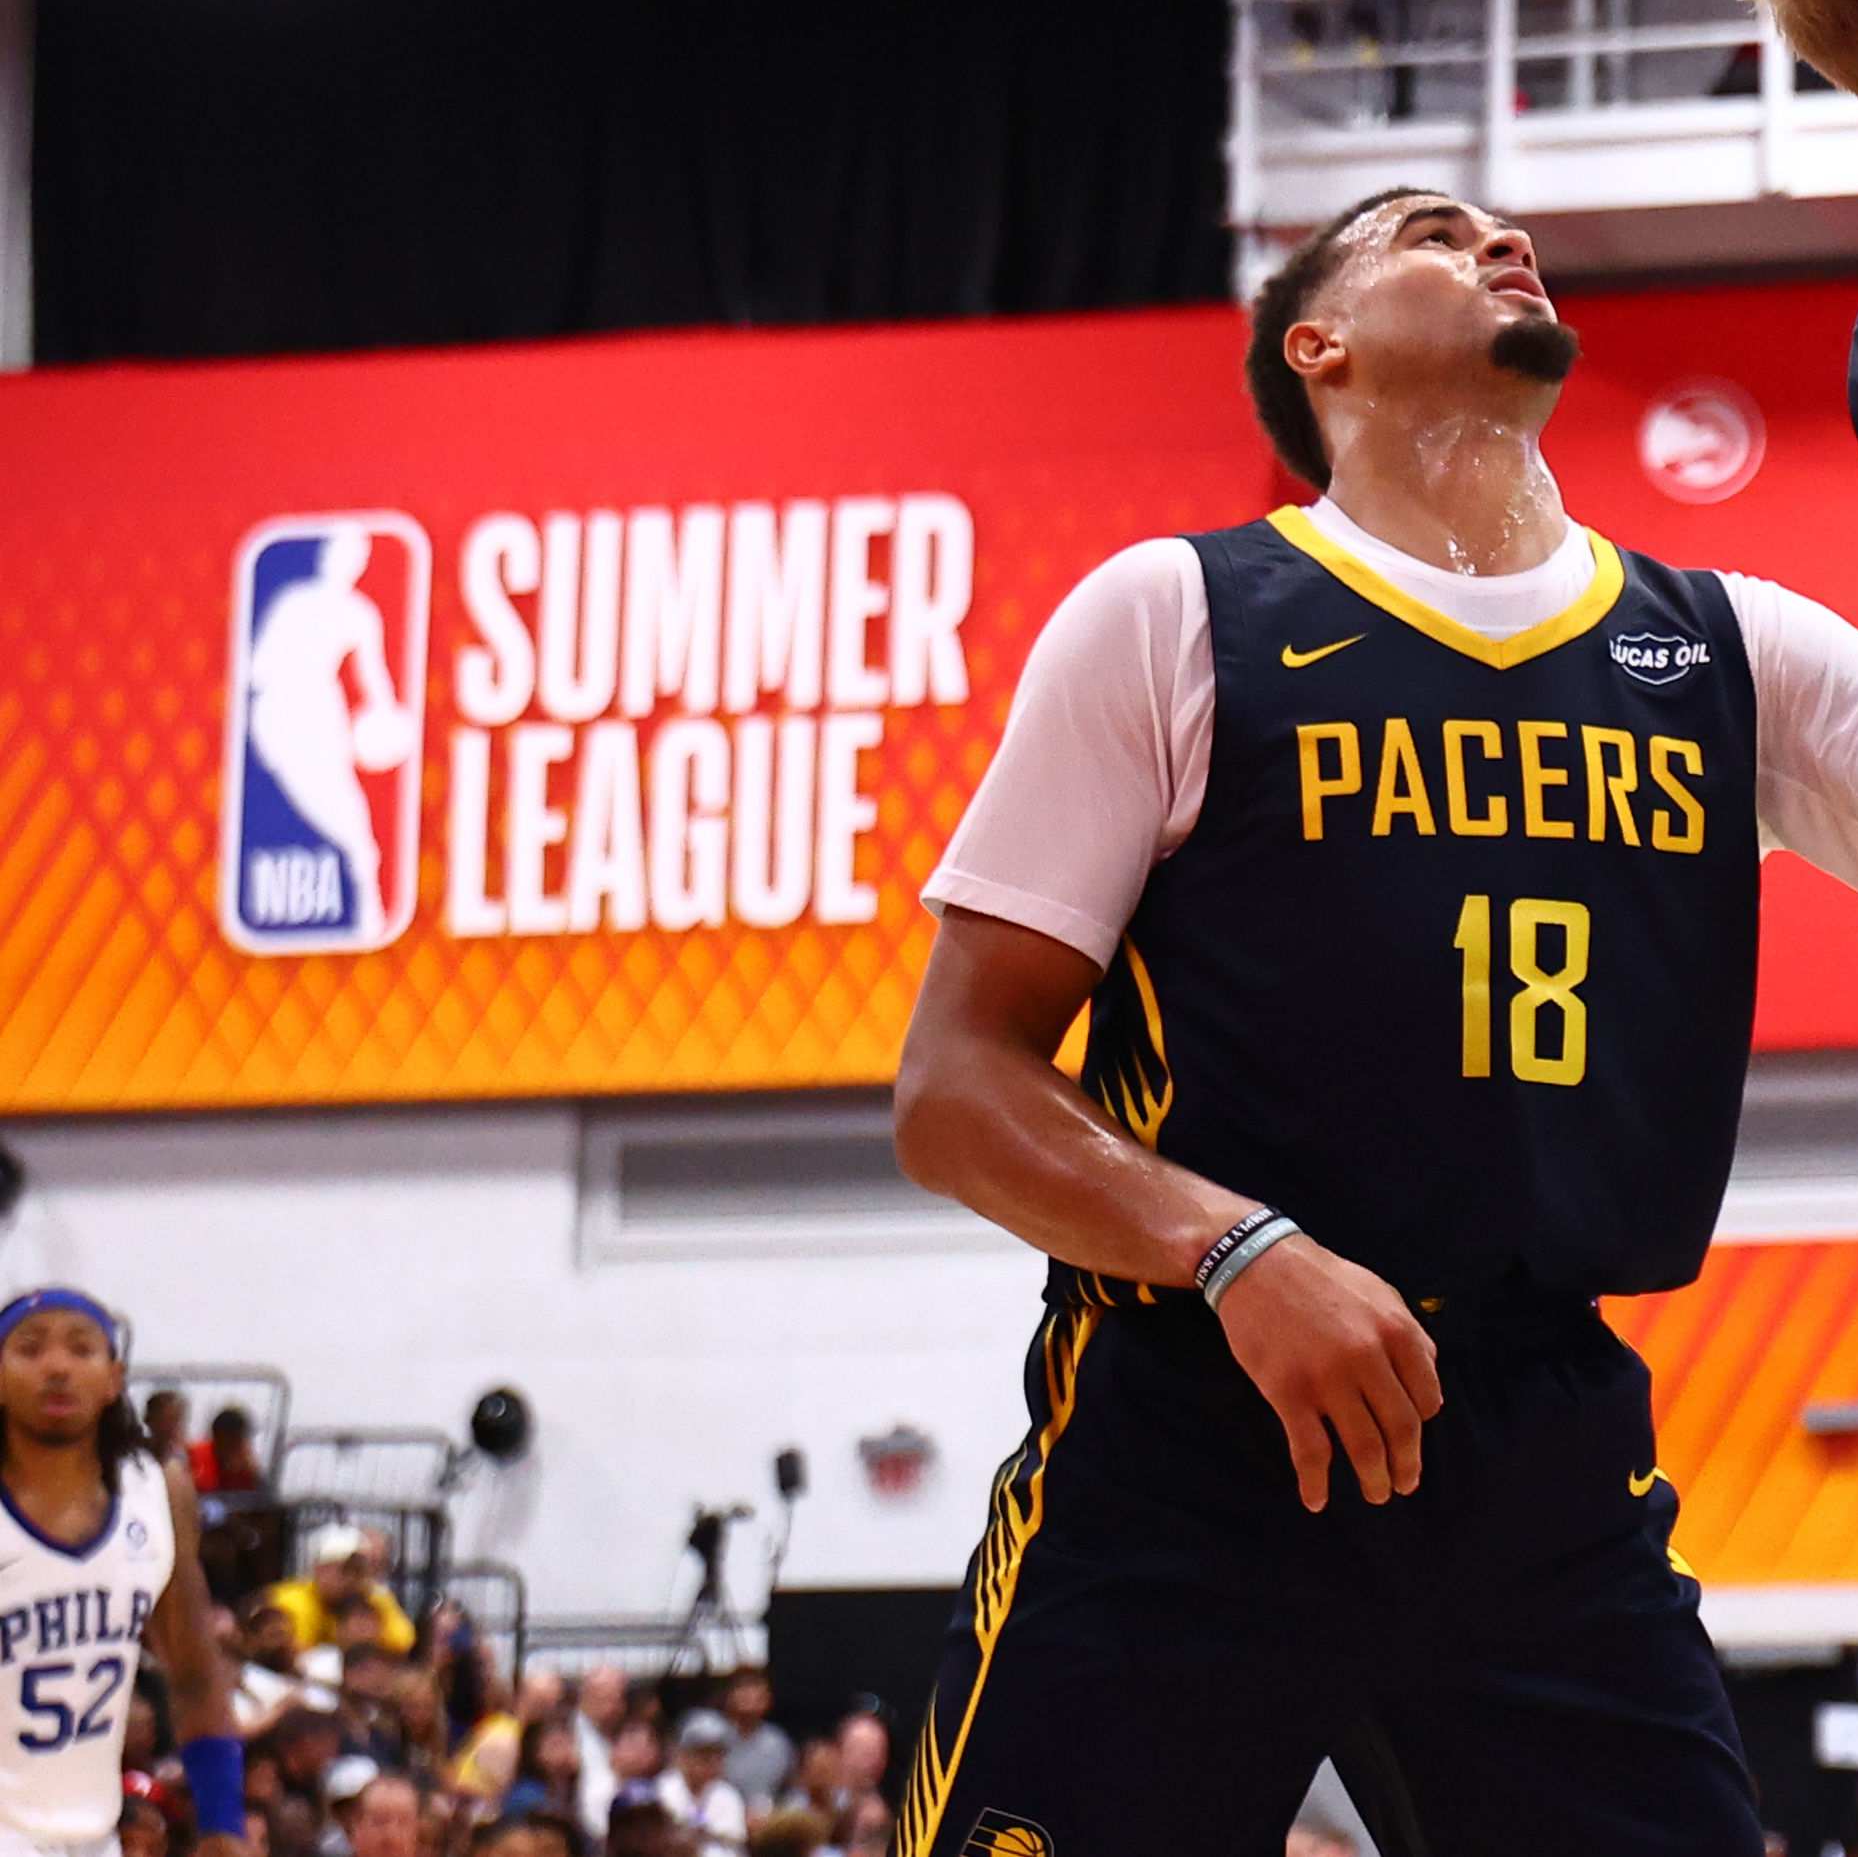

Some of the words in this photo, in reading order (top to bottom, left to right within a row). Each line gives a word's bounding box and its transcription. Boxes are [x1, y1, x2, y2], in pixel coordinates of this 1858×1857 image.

[455, 492, 976, 727] SUMMER
[1609, 639, 1670, 669] LUCAS
[1675, 643, 1711, 667] OIL
[448, 710, 885, 939] LEAGUE
[1296, 718, 1705, 855] PACERS
[250, 846, 342, 924] NBA
[1453, 894, 1591, 1086] 18
[18, 1656, 126, 1753] 52
